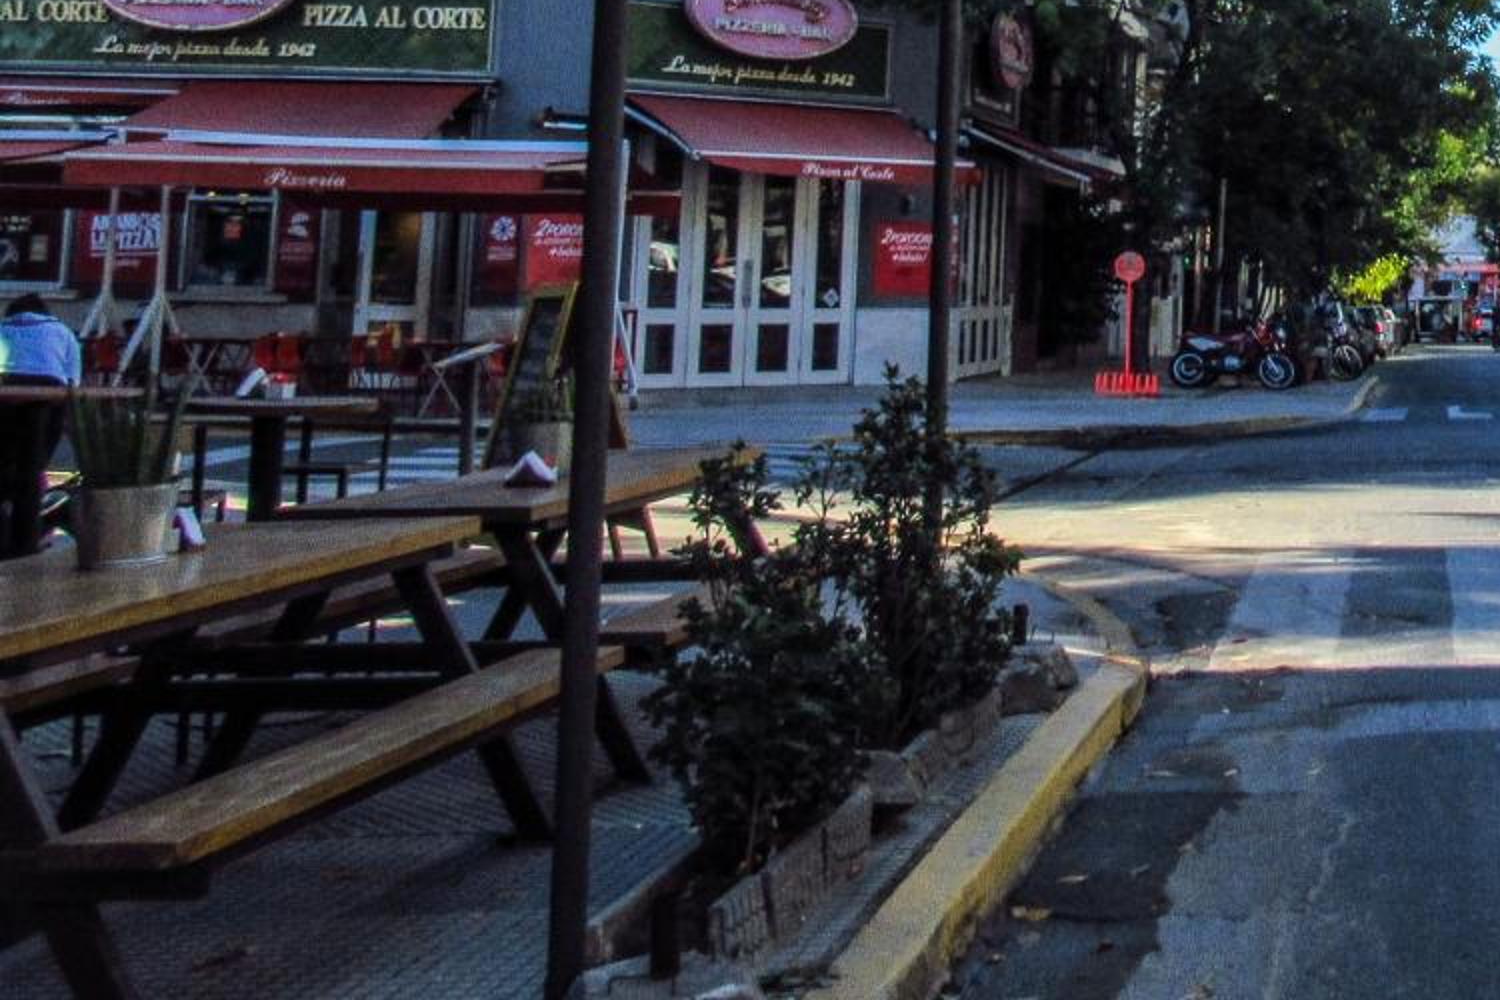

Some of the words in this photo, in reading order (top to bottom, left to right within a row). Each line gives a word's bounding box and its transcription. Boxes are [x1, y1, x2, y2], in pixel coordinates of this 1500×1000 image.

[0, 0, 29, 21] AL
[37, 0, 108, 22] CORTE
[303, 4, 368, 28] PIZZA
[374, 6, 407, 28] AL
[413, 6, 486, 30] CORTE
[93, 35, 124, 54] La
[127, 42, 172, 61] mejor
[173, 42, 220, 61] pizza
[223, 38, 270, 57] desde
[277, 42, 317, 57] 1942
[661, 55, 690, 73] La
[692, 62, 733, 82] mejor
[734, 65, 775, 84] pizza
[776, 65, 816, 85] desde
[821, 71, 856, 87] 1942
[802, 162, 841, 178] Pizza
[859, 165, 896, 180] Corte
